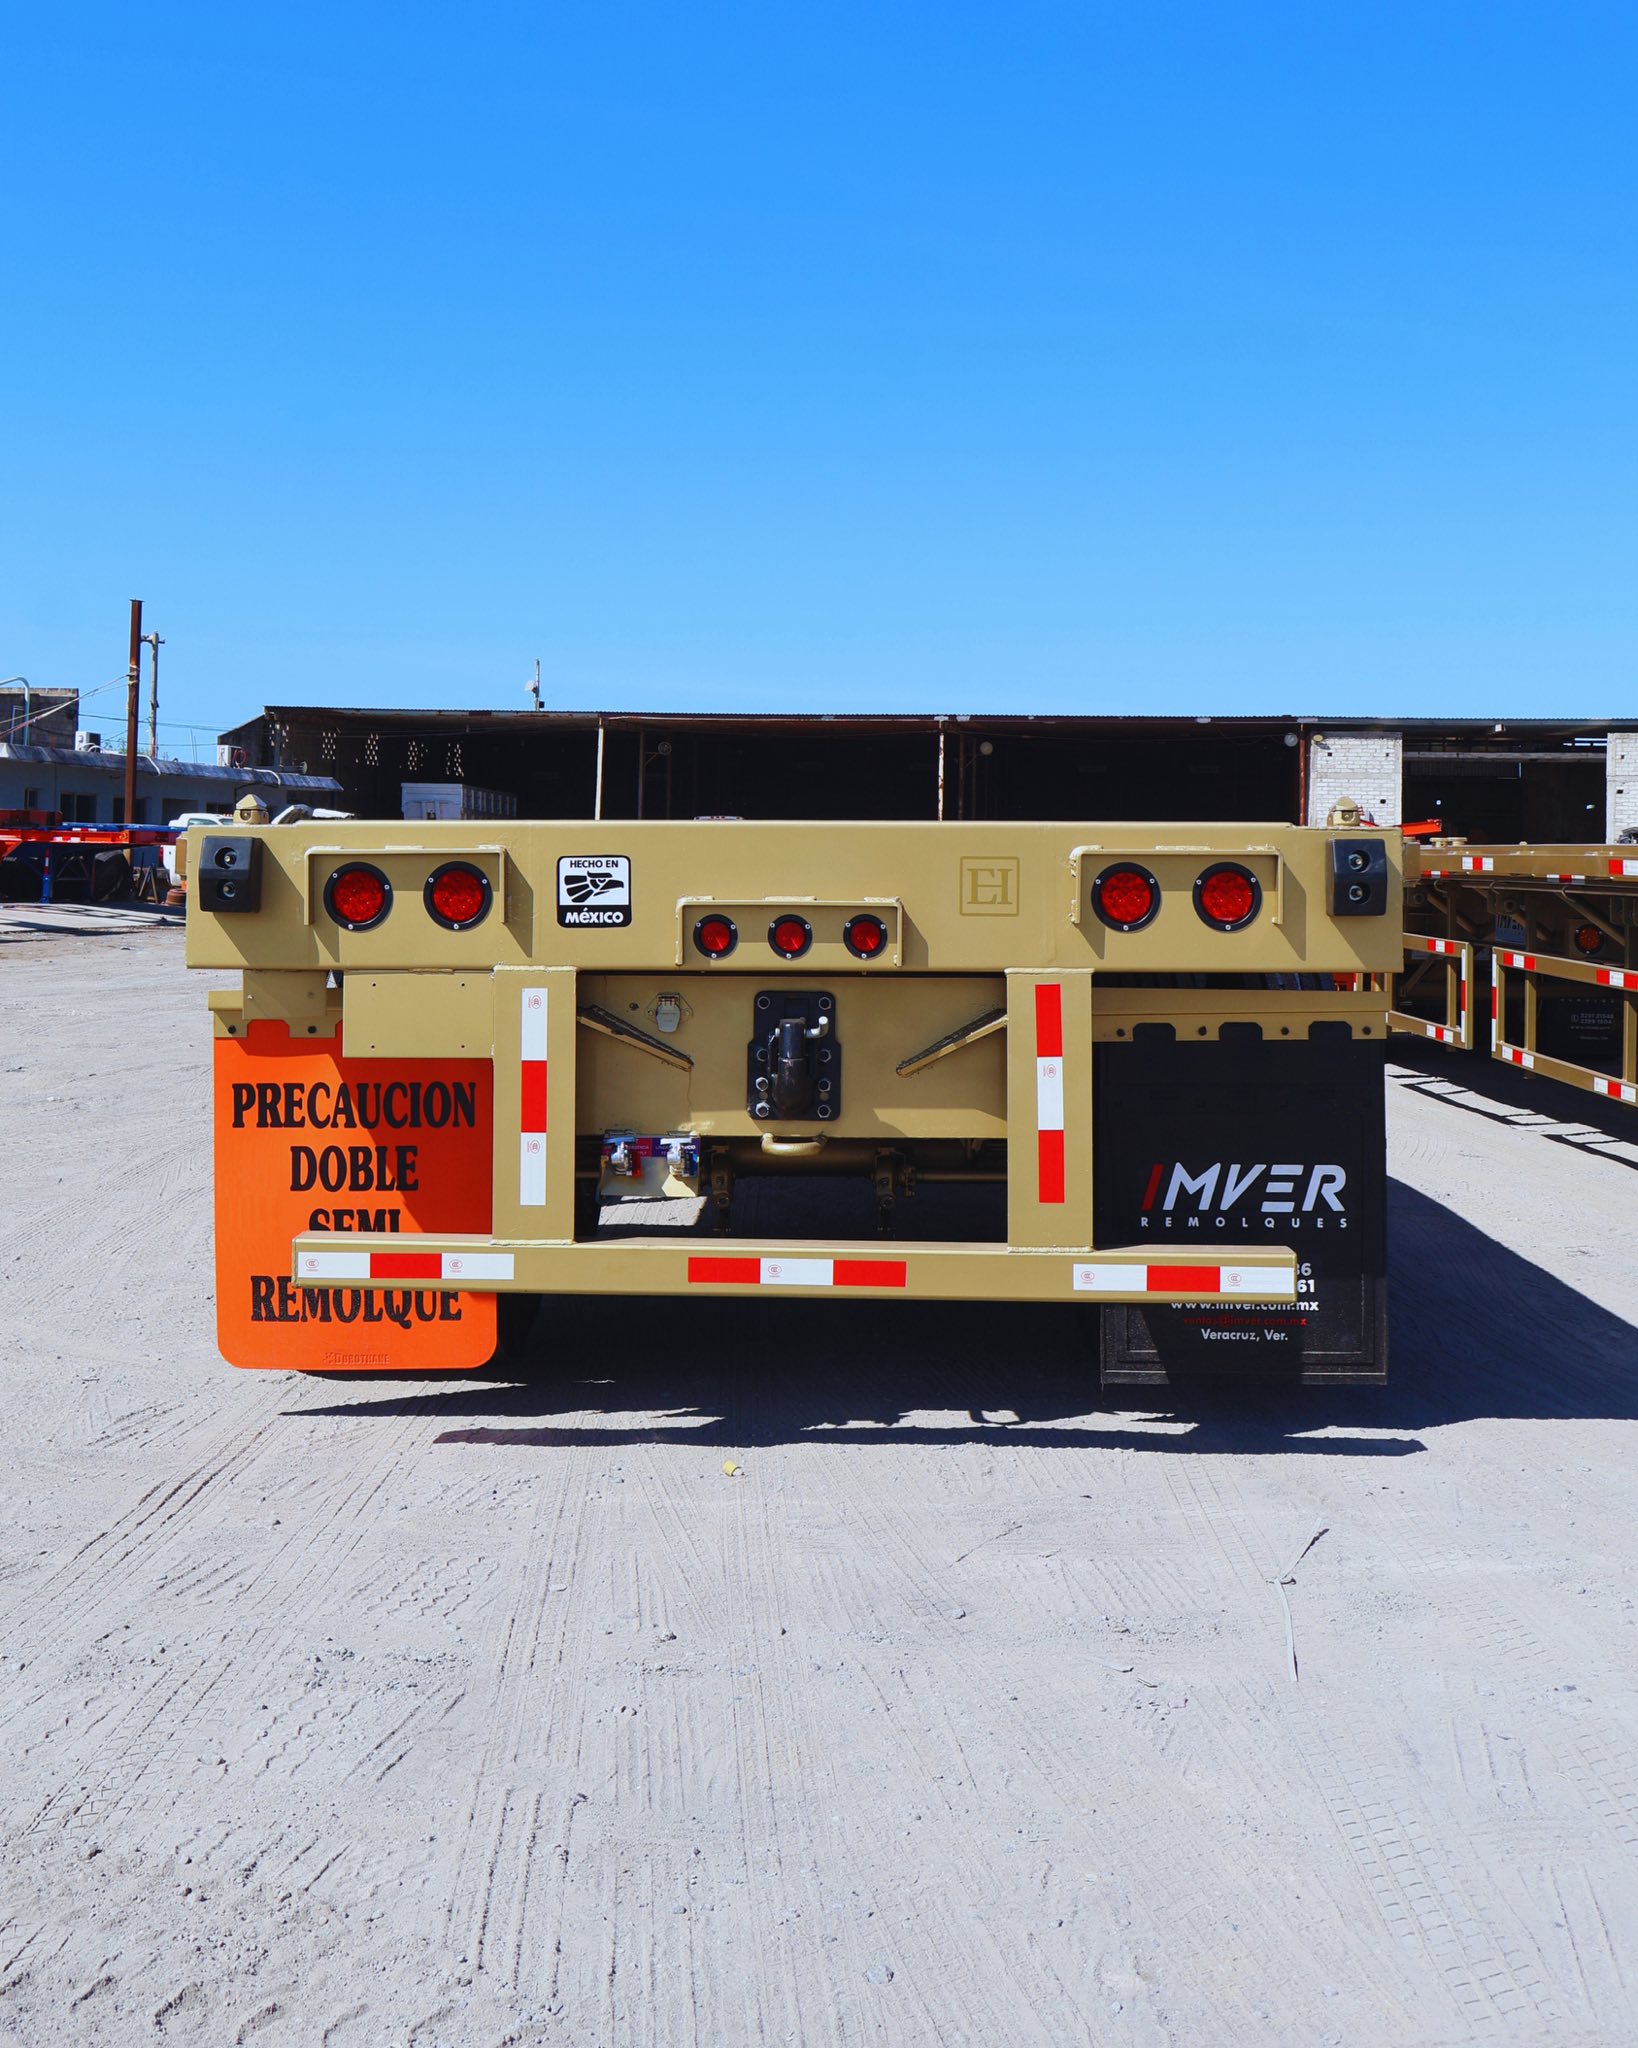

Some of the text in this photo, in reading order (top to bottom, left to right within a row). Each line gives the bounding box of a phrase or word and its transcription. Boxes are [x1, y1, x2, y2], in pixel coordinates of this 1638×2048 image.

[570, 860, 619, 868] HECHO EN
[231, 1081, 477, 1129] PRECAUCION
[289, 1145, 420, 1192] DOBLE
[1141, 1162, 1347, 1213] IMVER
[1140, 1216, 1348, 1229] REMOLQUES
[250, 1275, 463, 1329] REMOLQUE
[1201, 1328, 1289, 1342] Veracruz, Ver.
